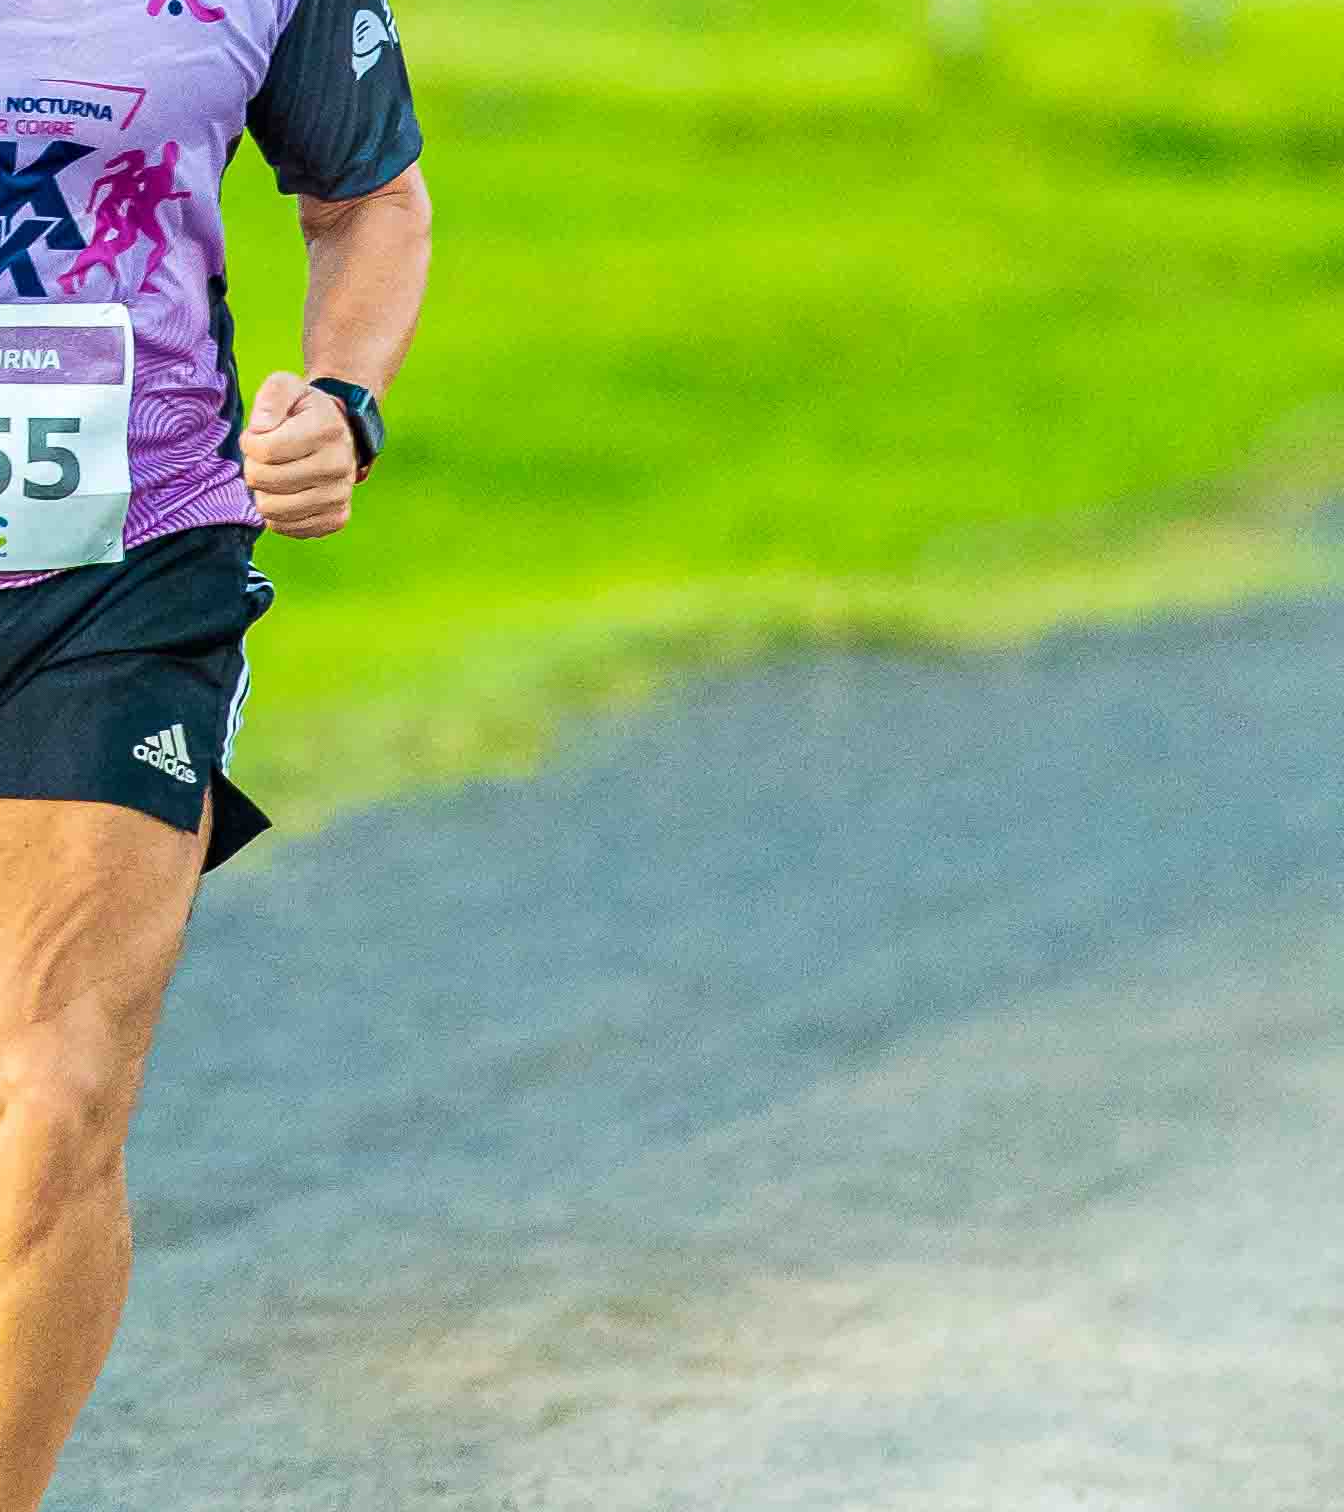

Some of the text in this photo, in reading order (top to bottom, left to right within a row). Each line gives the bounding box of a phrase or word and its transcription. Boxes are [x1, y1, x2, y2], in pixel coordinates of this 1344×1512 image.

[6, 96, 113, 122] NOCTURNA
[16, 119, 76, 136] CORRE
[133, 744, 197, 784] adidas
